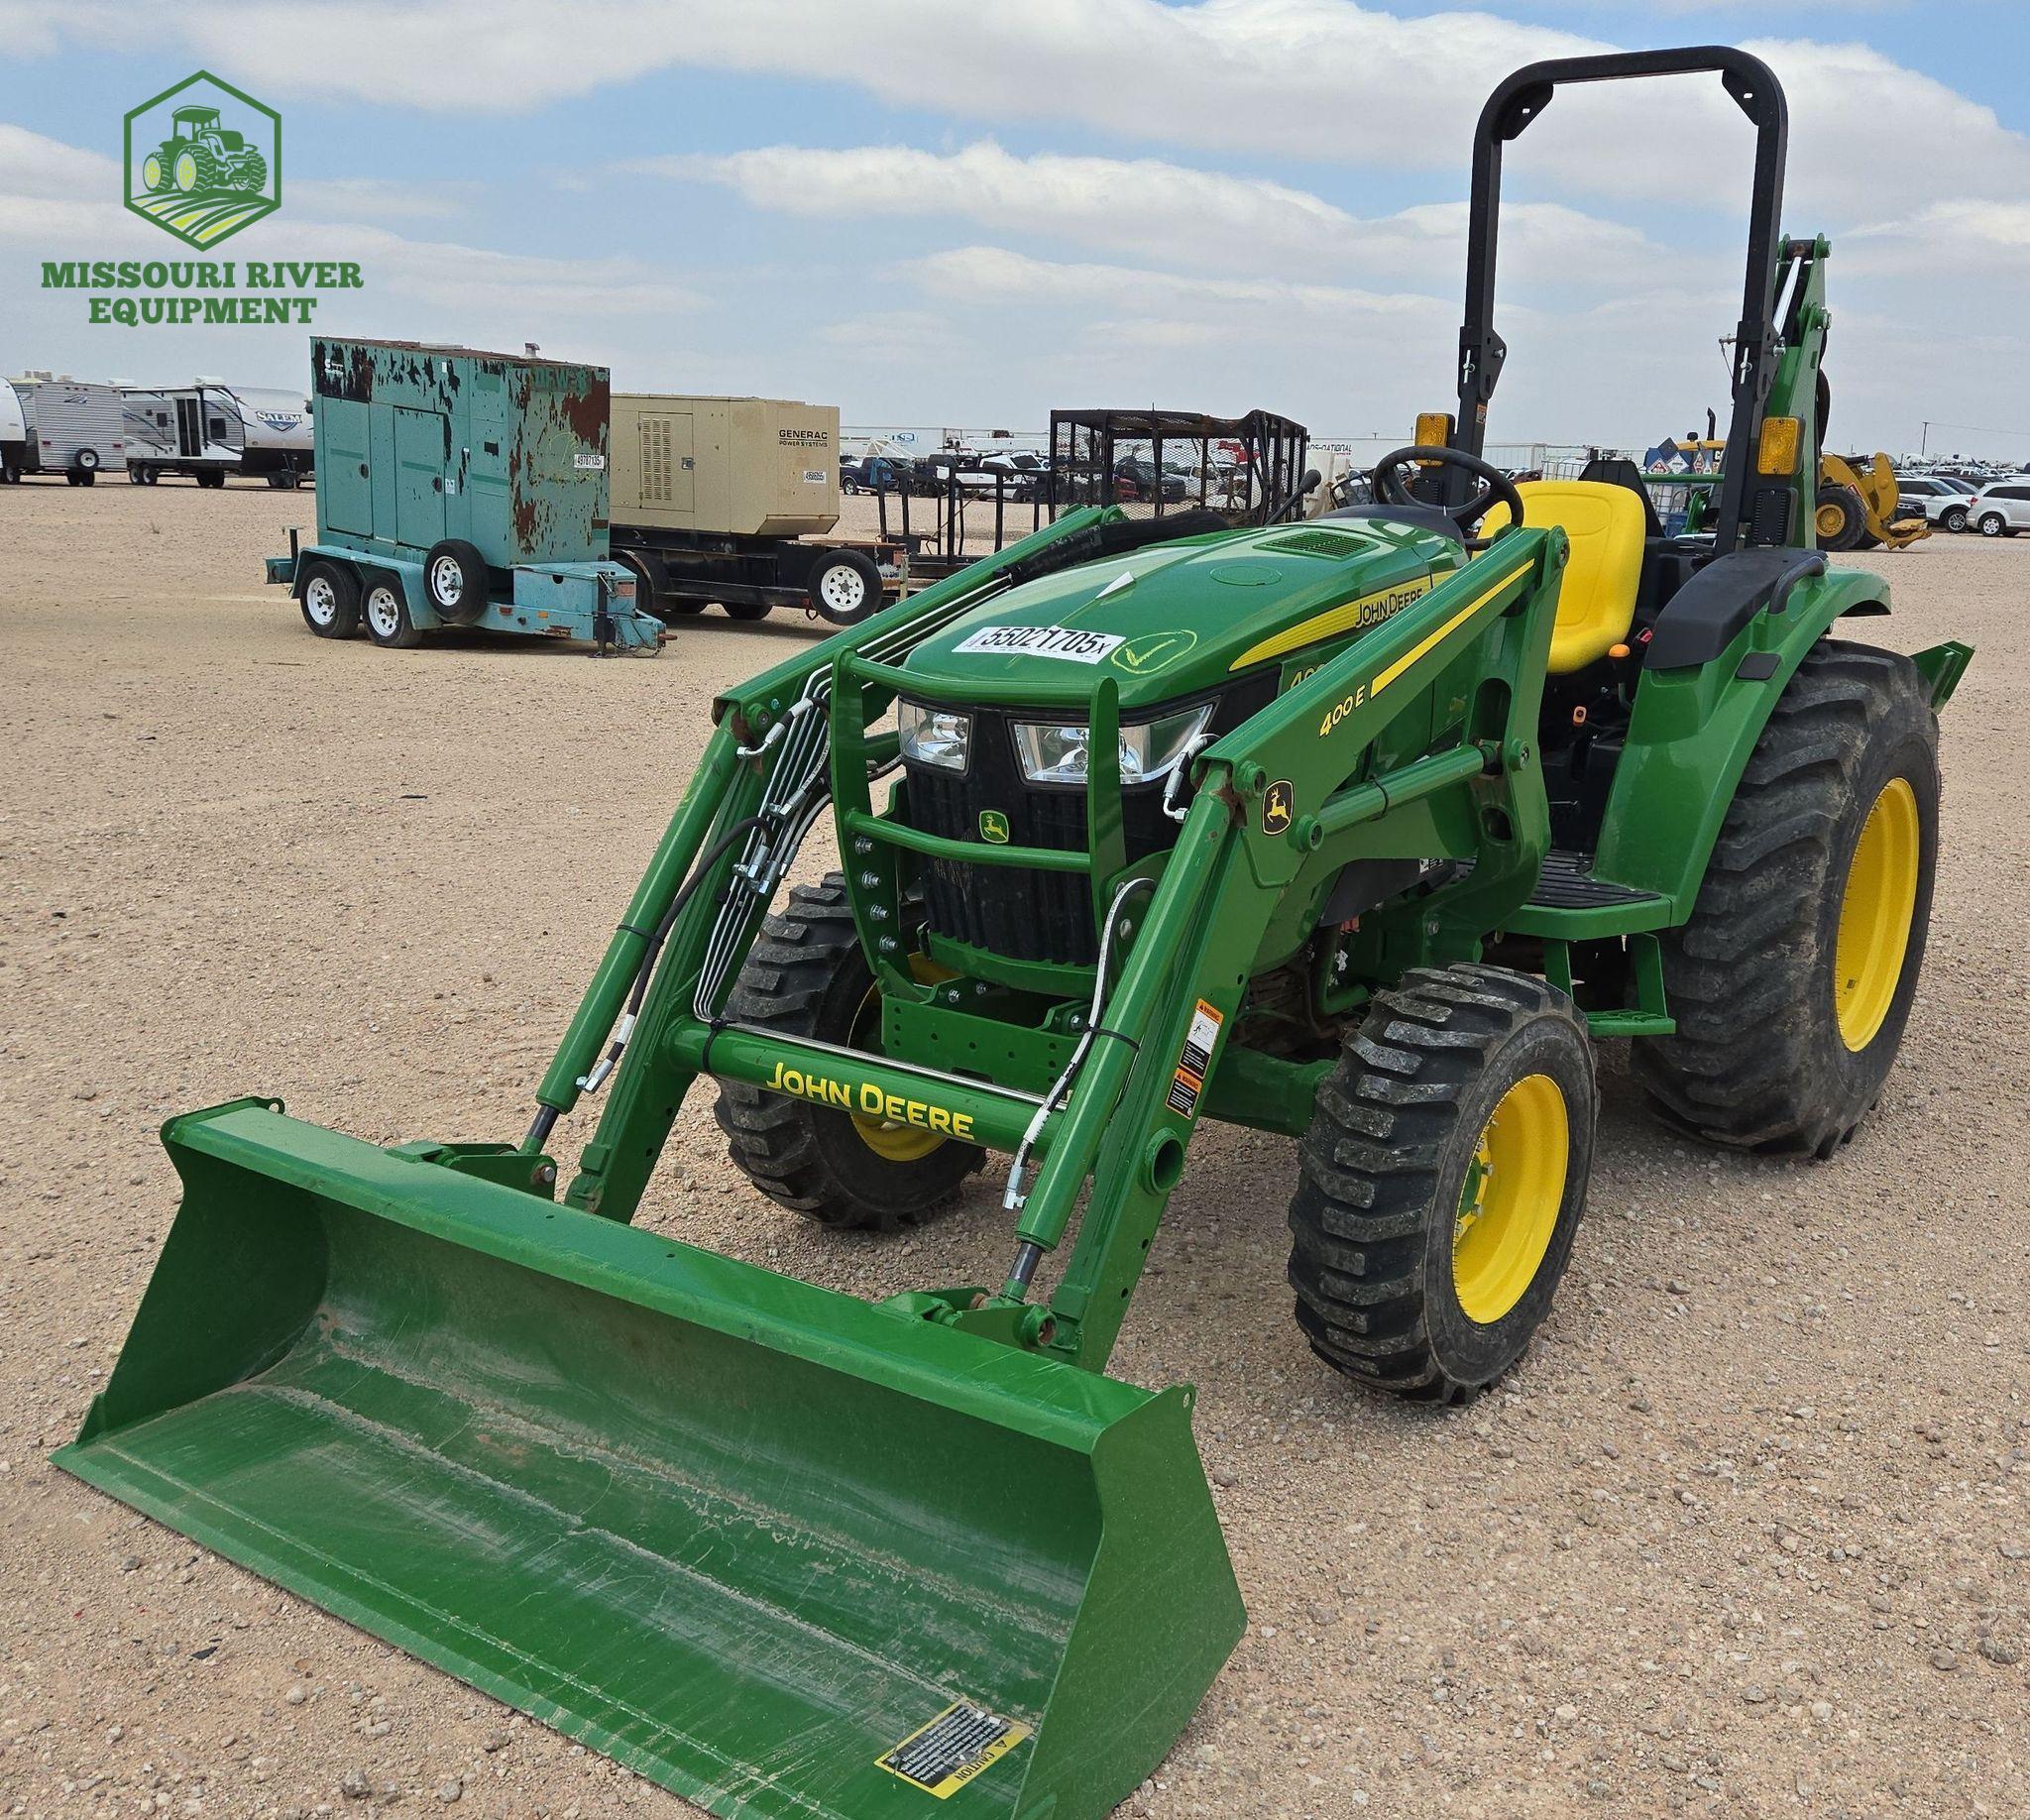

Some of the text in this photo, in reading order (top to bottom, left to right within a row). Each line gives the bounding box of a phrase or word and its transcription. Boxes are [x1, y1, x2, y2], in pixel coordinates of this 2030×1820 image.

[256, 410, 302, 423] SALEM
[779, 429, 828, 439] GENERAC
[1356, 601, 1388, 627] JOHN
[766, 1062, 974, 1140] JOHN DEERE
[954, 1752, 995, 1781] CAUTION
